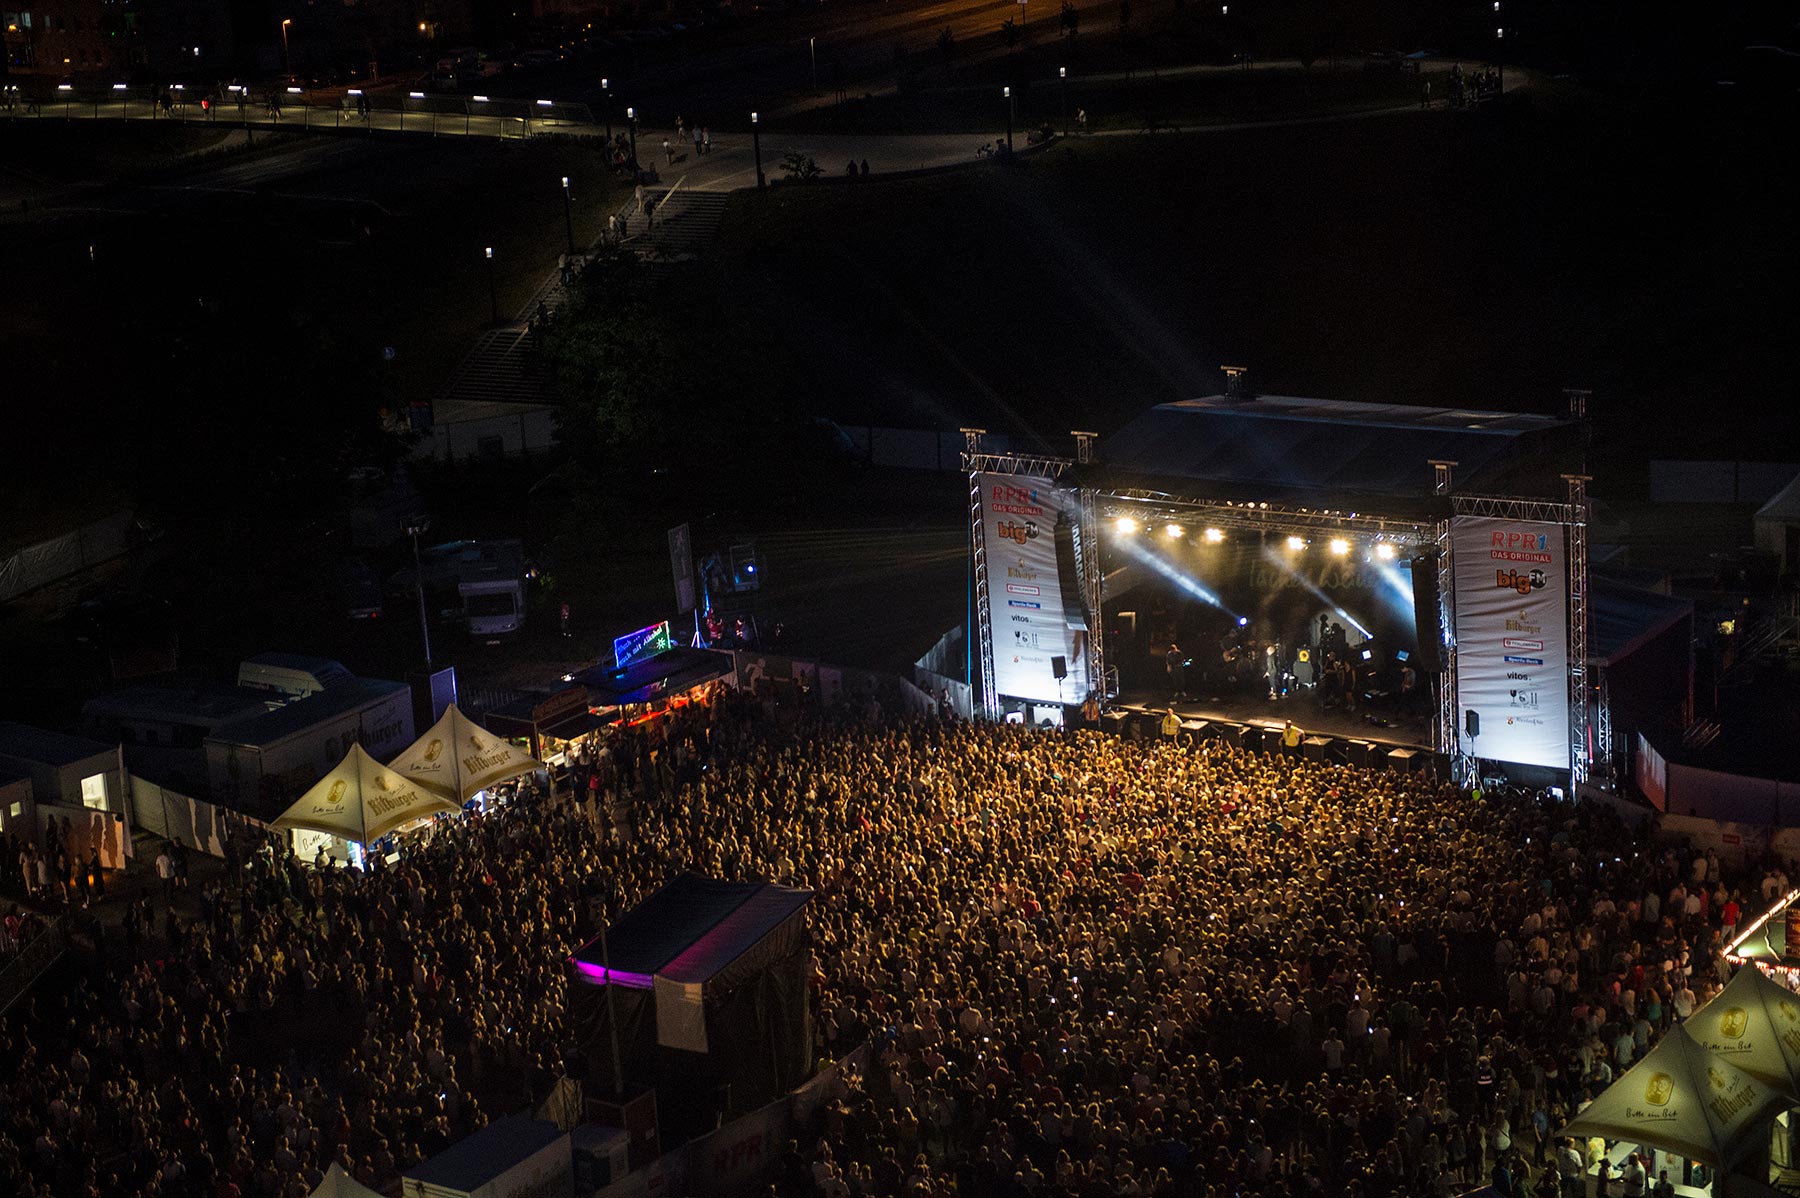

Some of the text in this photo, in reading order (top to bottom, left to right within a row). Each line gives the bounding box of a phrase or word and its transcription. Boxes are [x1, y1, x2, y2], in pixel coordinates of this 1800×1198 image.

[993, 504, 1042, 515] DAS ORIGINAL
[1492, 551, 1550, 563] DAS ORIGINAL
[1506, 619, 1541, 634] Bitburger
[463, 751, 512, 775] Bitburger
[367, 791, 418, 816] Bitburger
[1710, 1085, 1756, 1125] Bitburger
